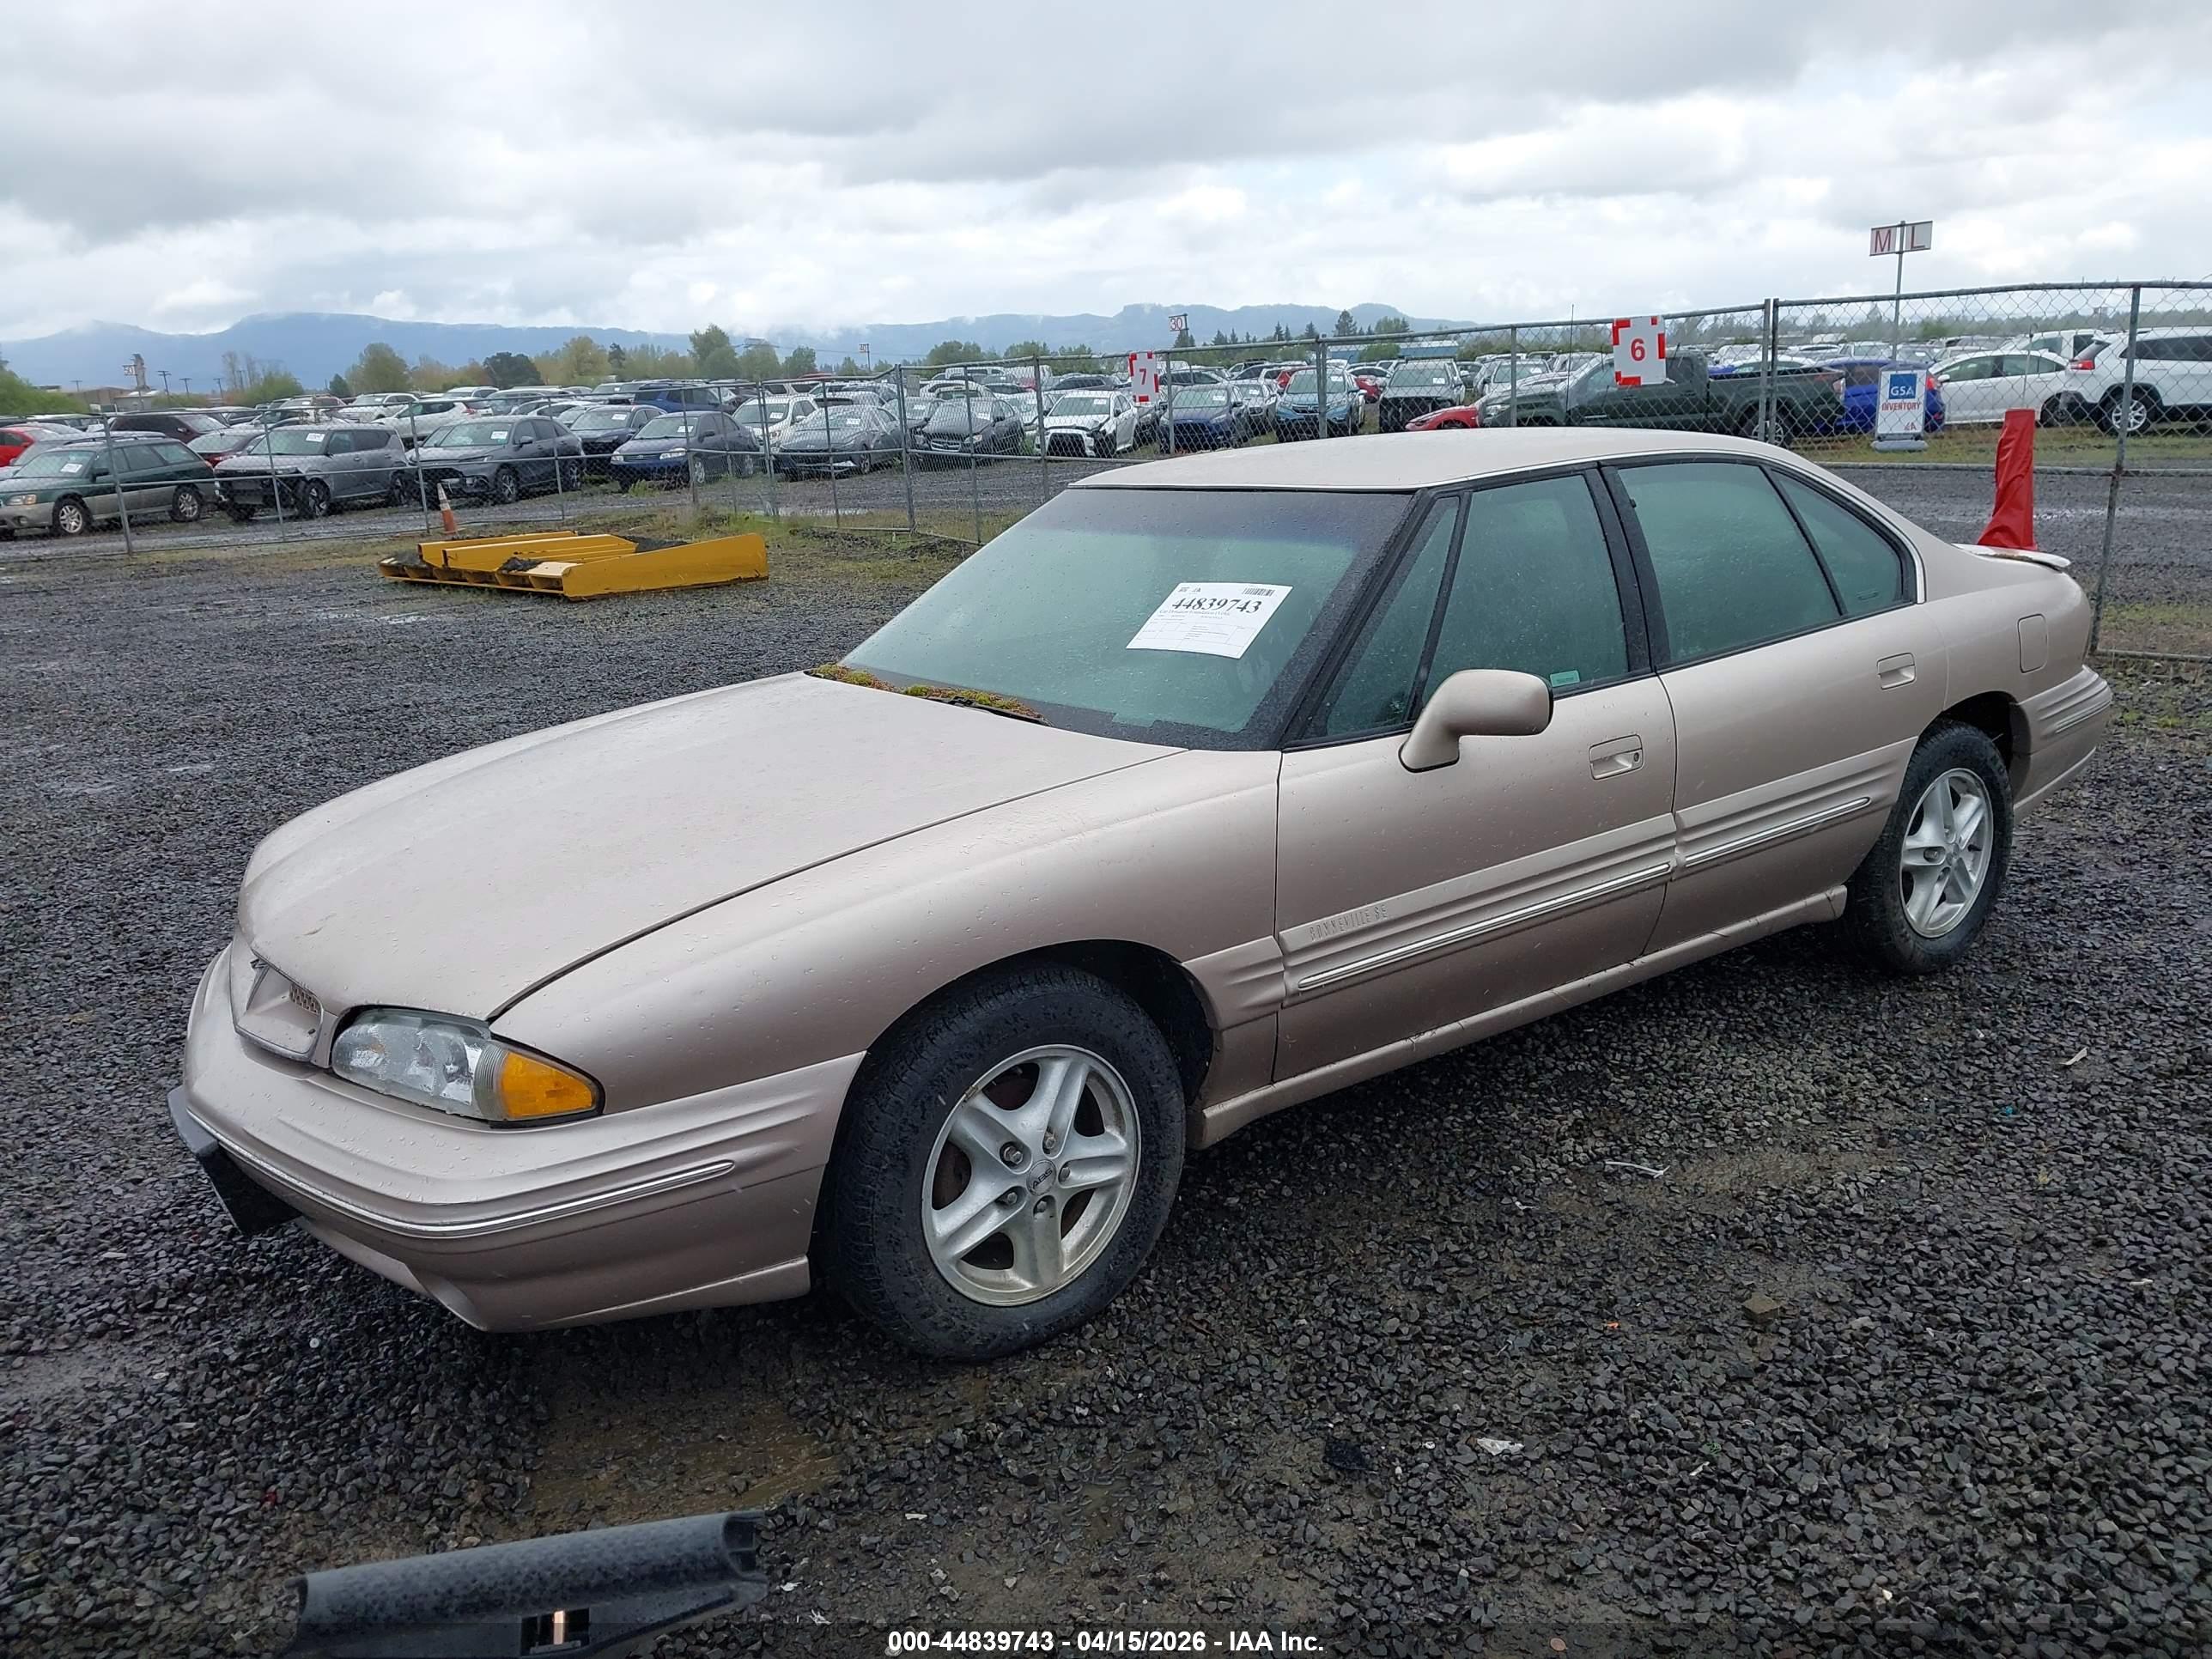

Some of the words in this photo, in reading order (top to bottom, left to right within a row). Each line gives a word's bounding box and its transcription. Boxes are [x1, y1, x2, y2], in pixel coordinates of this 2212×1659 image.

[1875, 229, 1892, 253] M
[1911, 226, 1926, 249] L
[1170, 317, 1183, 331] 30
[1631, 337, 1646, 362] 6
[1139, 368, 1147, 386] 7
[1890, 386, 1915, 396] GSA
[1881, 402, 1921, 411] INVENTORY
[1172, 597, 1262, 613] 44839743
[1032, 1168, 1053, 1188] ABS
